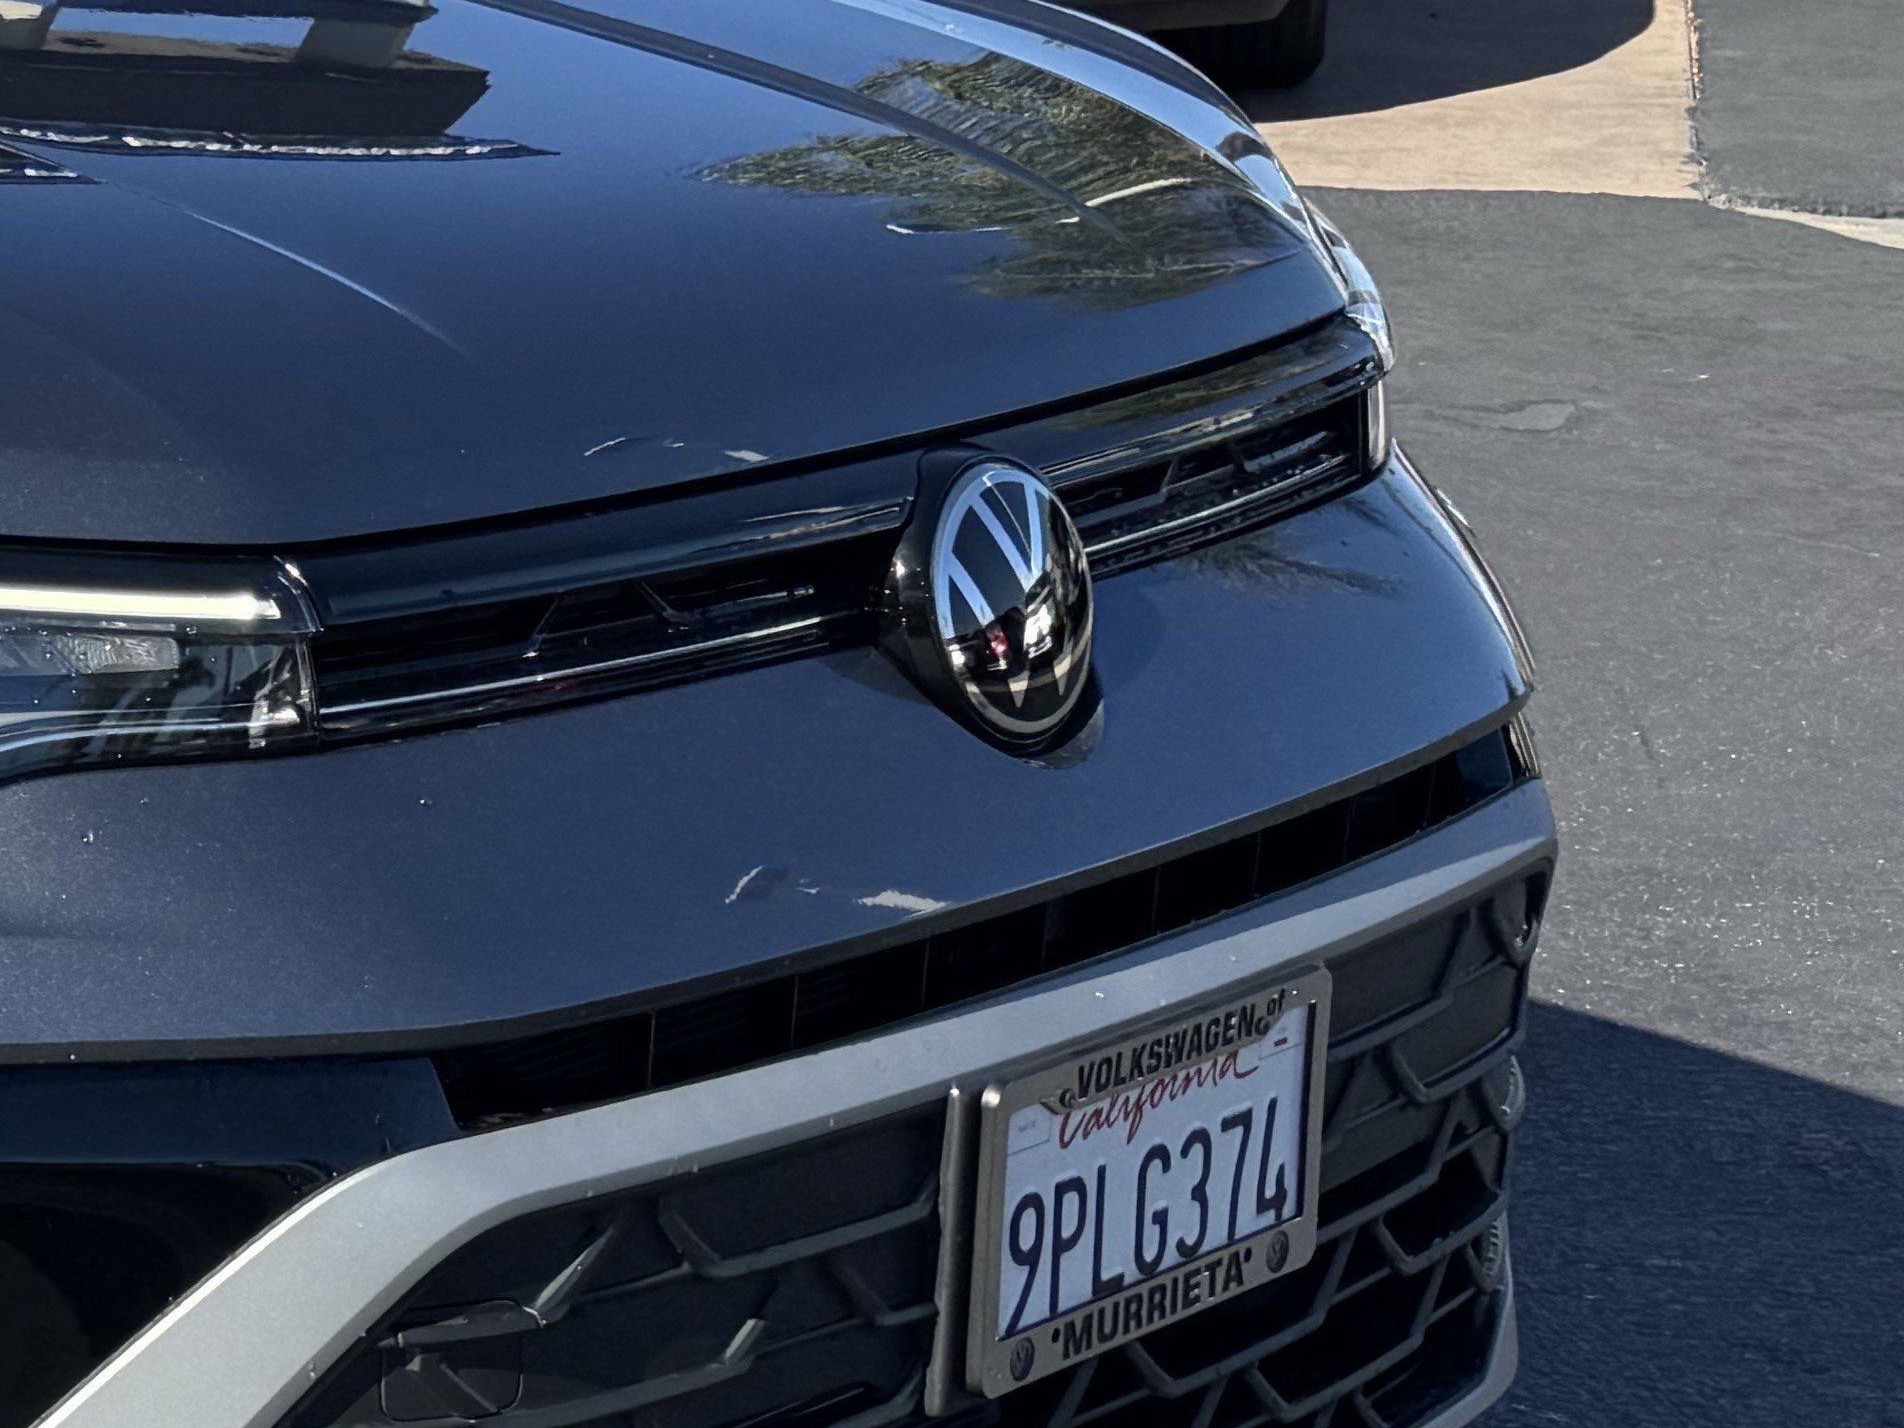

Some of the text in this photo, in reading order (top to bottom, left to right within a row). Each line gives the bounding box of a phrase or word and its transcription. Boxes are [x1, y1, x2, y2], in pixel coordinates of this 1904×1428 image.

[1058, 1048, 1260, 1150] California
[1076, 987, 1287, 1100] VOLKSWAGEN of
[1004, 1095, 1288, 1338] 9PLG374
[1061, 1249, 1245, 1362] MURRIETA
